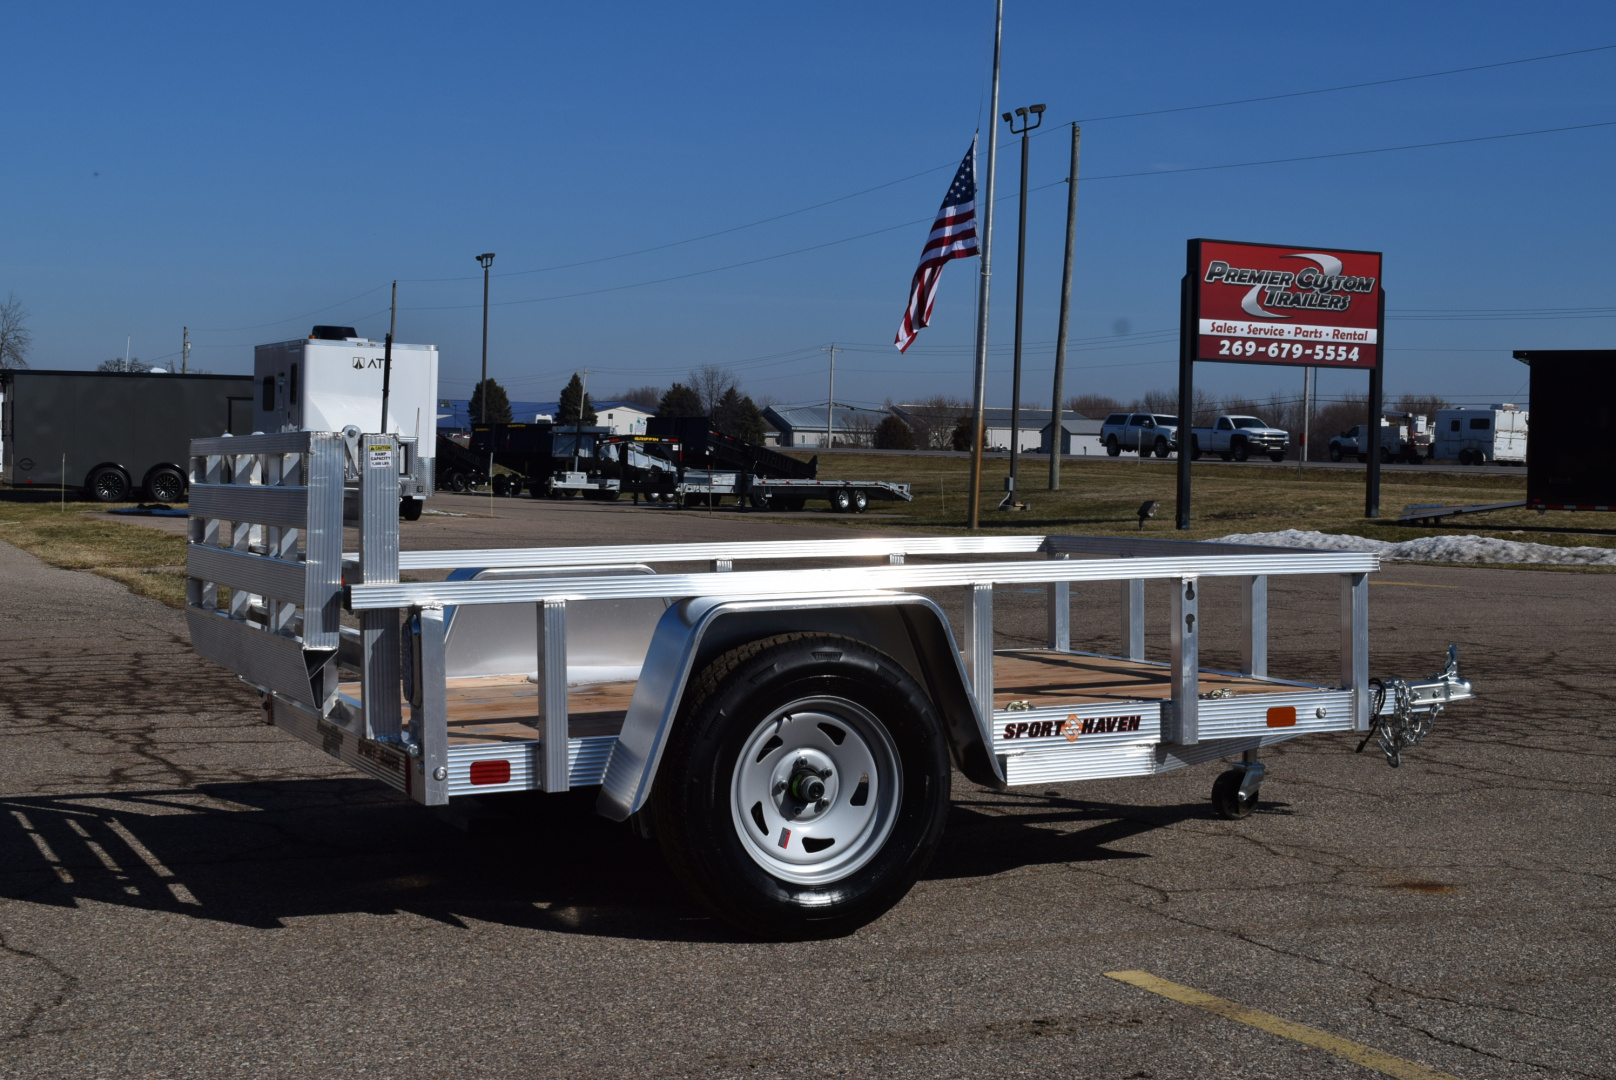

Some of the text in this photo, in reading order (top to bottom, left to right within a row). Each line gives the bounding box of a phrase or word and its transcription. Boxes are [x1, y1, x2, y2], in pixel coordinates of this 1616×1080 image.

[1205, 261, 1375, 293] PREMIER CUSTOM
[1264, 286, 1350, 310] TRAILERS
[1210, 321, 1369, 341] Sales Service Parts Rental
[1219, 340, 1359, 361] 269-679-5554
[1003, 715, 1141, 739] SPORT HAVEN
